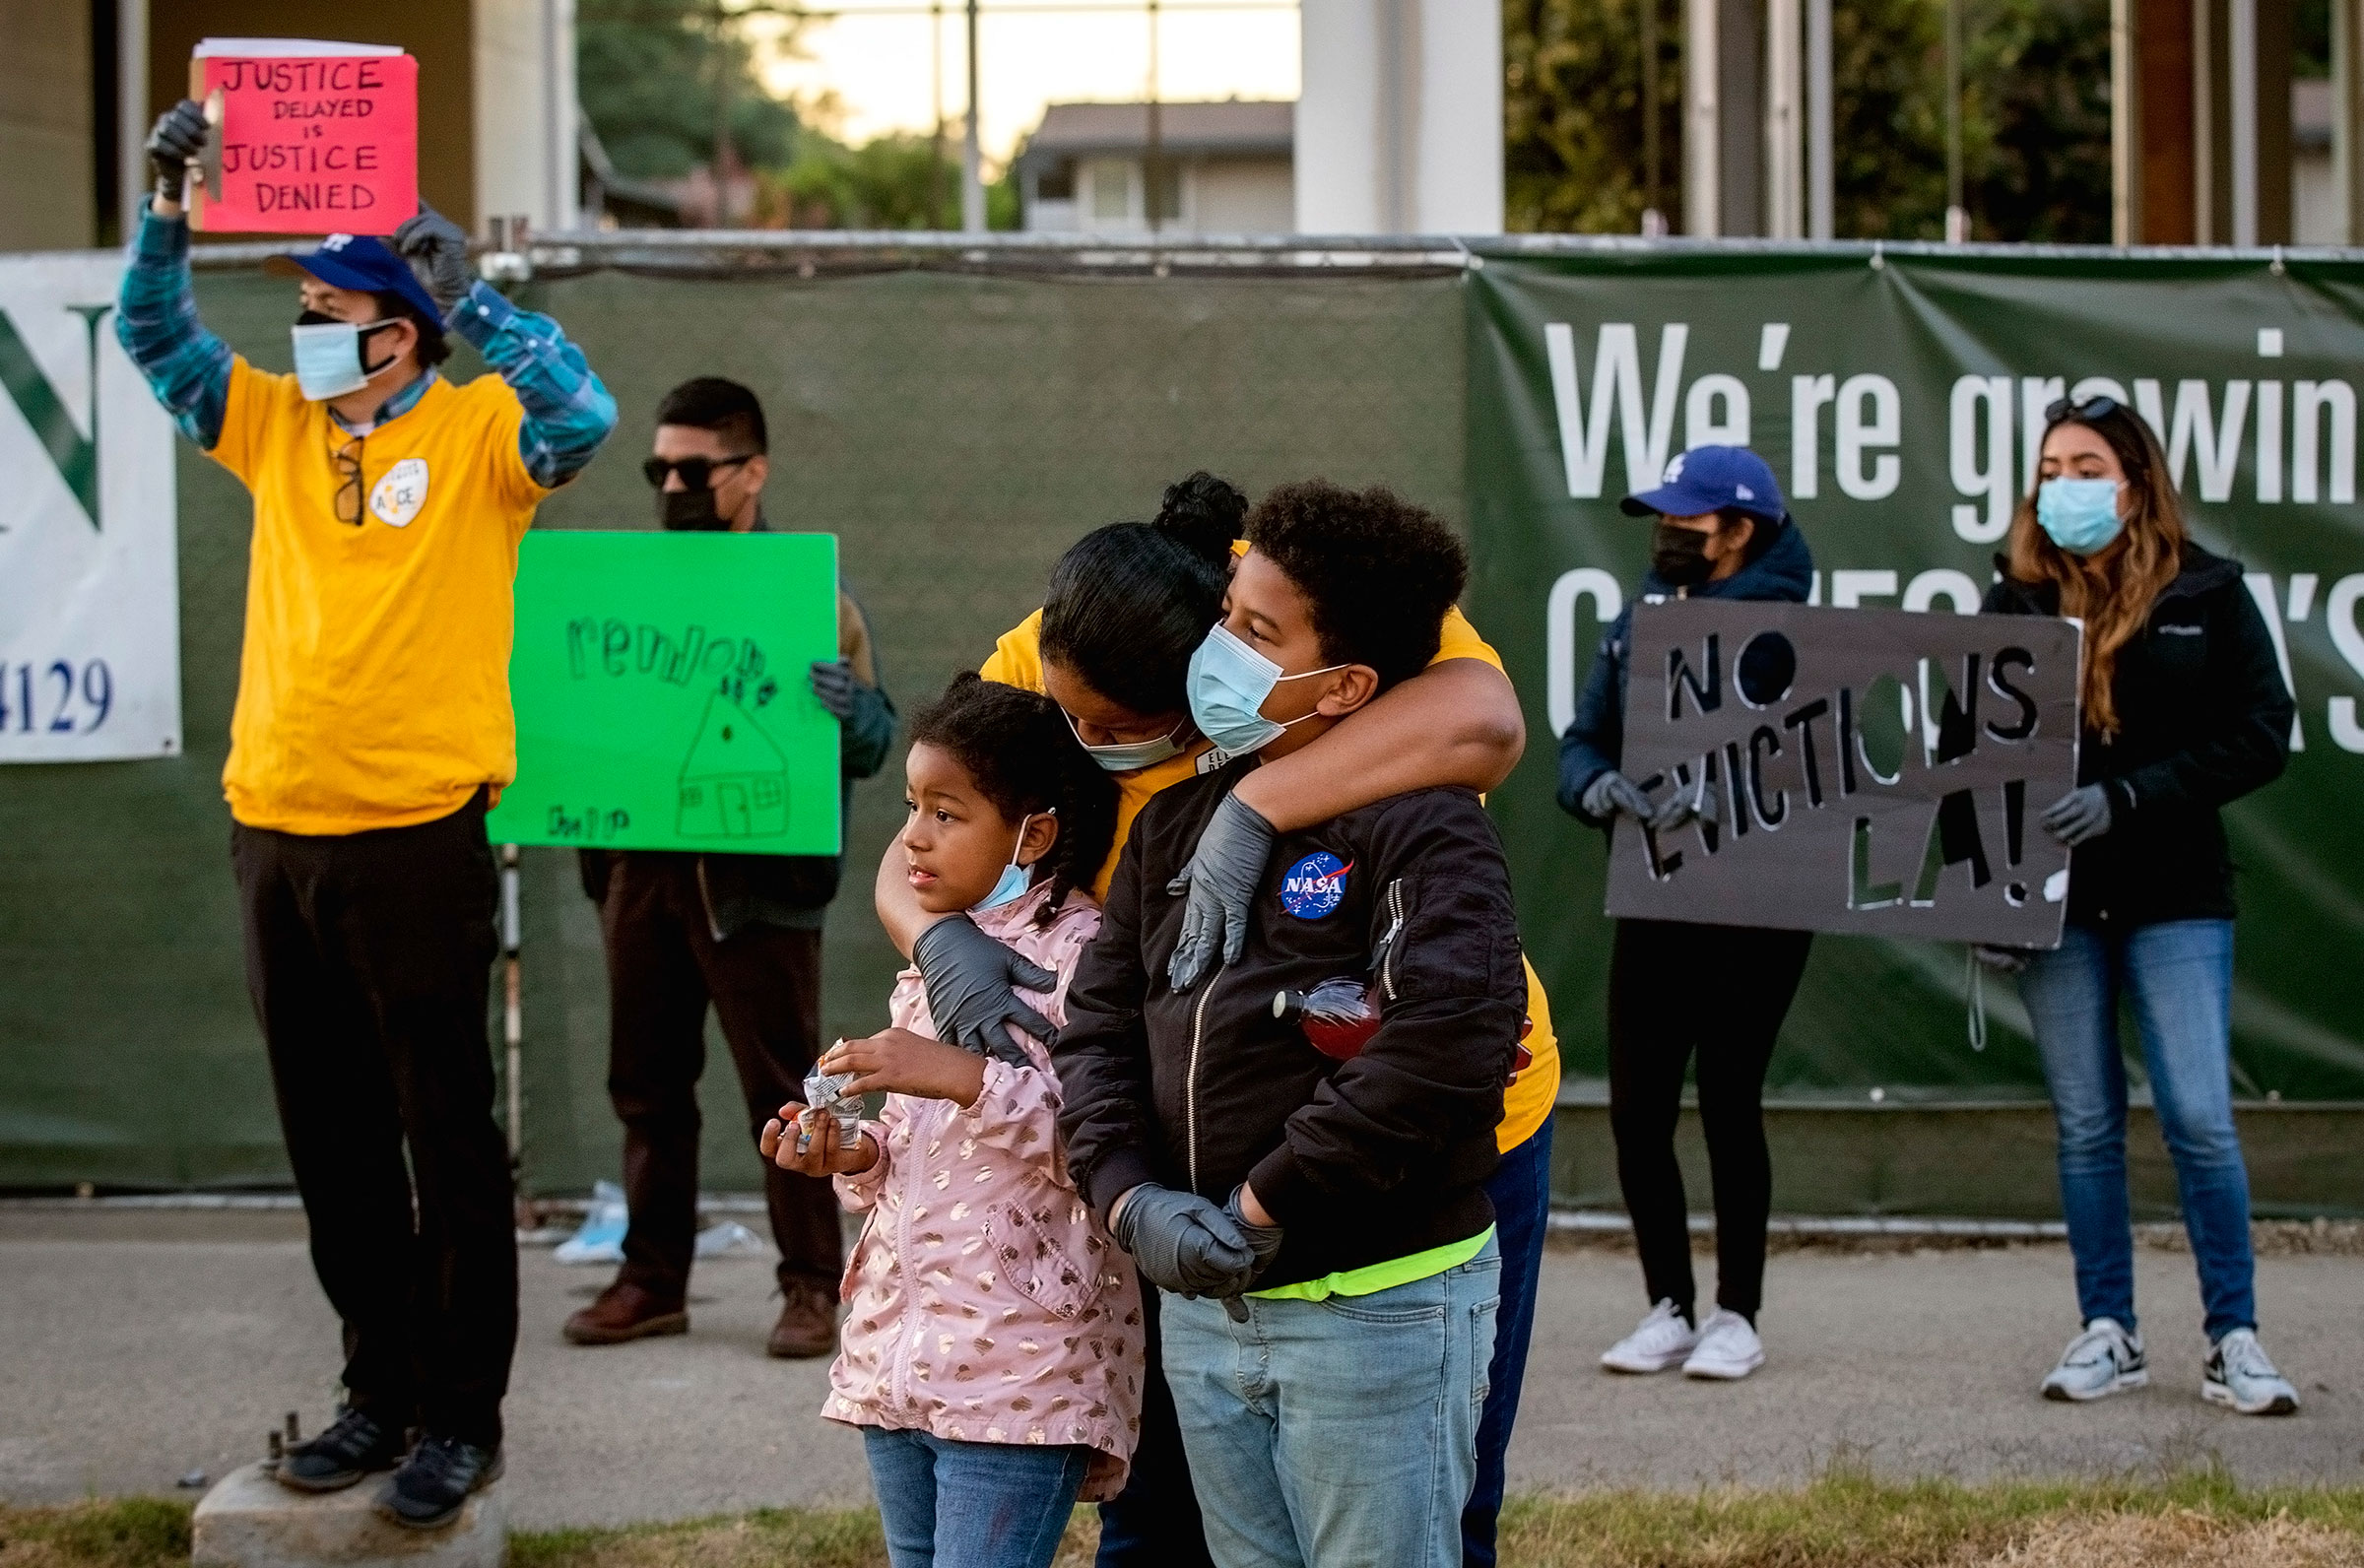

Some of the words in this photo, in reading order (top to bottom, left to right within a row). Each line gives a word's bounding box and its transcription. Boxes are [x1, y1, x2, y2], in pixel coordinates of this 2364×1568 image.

[223, 60, 383, 93] JUSTICE
[274, 99, 373, 119] DELAYED
[223, 145, 378, 172] JUSTICE
[256, 182, 375, 212] DENIED
[1545, 322, 1901, 500] We're
[1949, 328, 2357, 544] grwin
[1669, 631, 1797, 720] NO
[0, 659, 115, 735] 129
[1848, 781, 2028, 910] LA!
[1284, 877, 1343, 893] NASA
